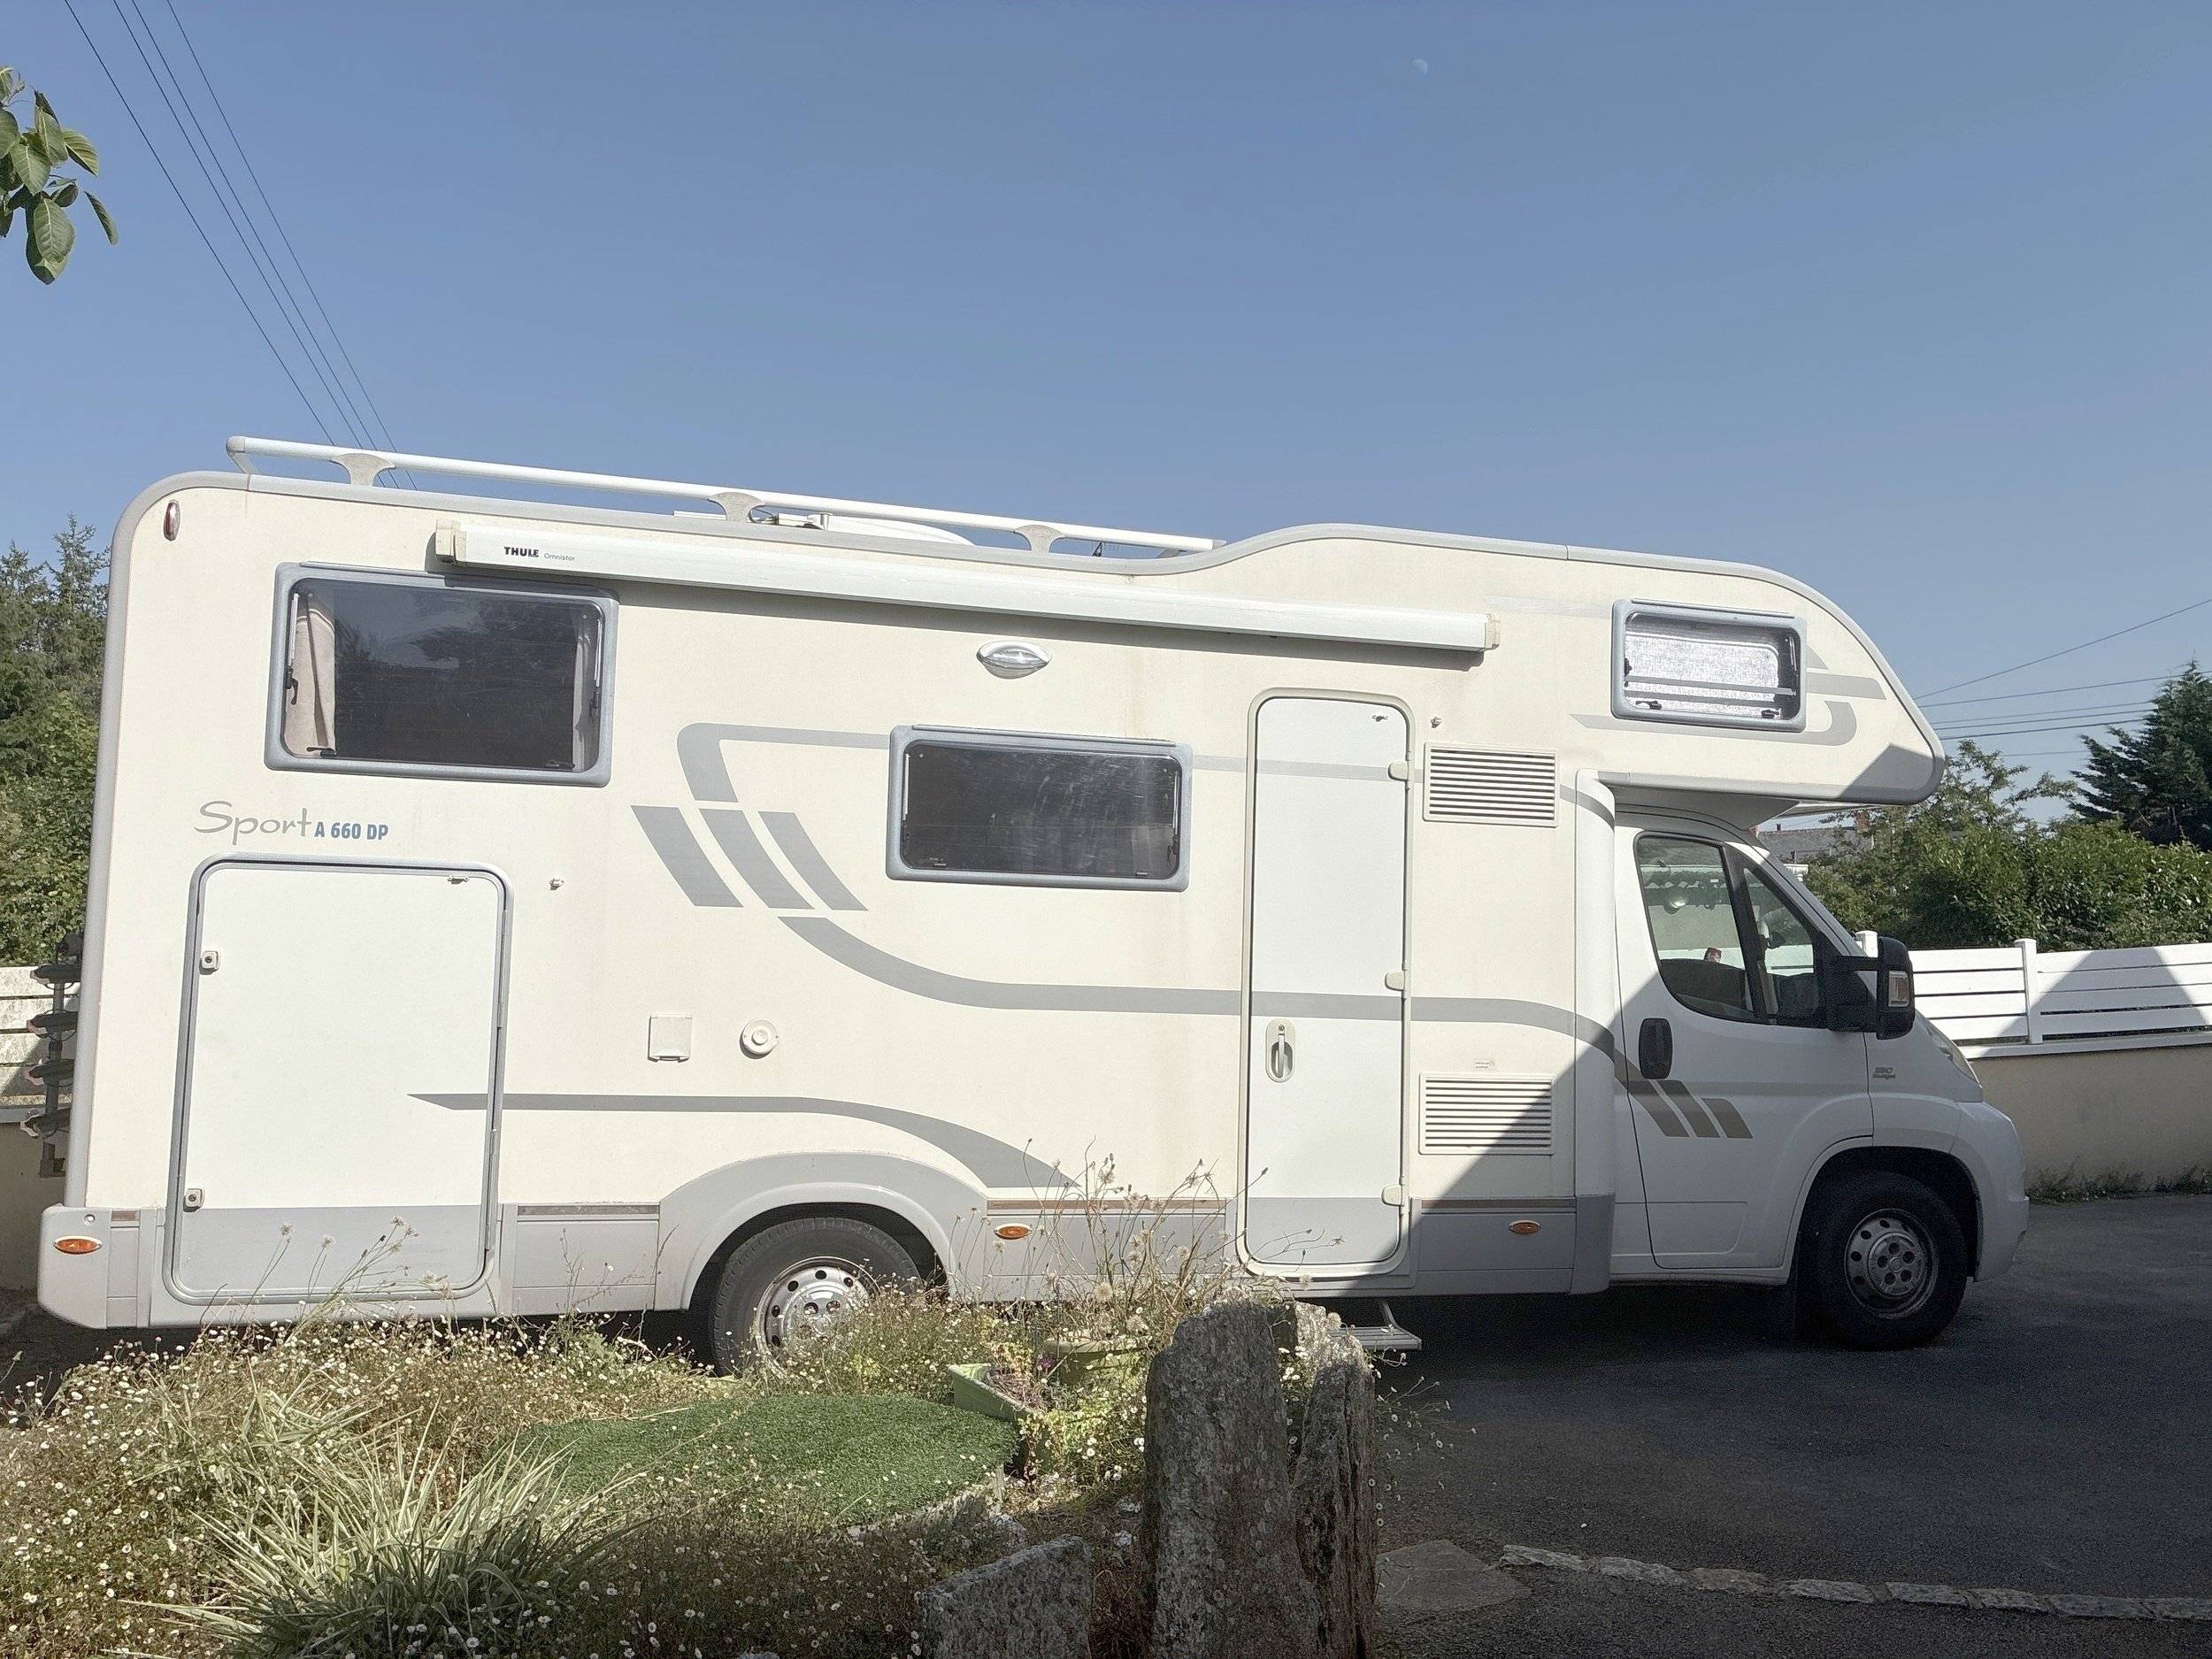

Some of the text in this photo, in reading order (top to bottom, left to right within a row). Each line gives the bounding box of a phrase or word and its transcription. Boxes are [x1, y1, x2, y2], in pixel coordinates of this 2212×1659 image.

[503, 546, 539, 557] THULE
[194, 800, 389, 845] Sport A 660 DP
